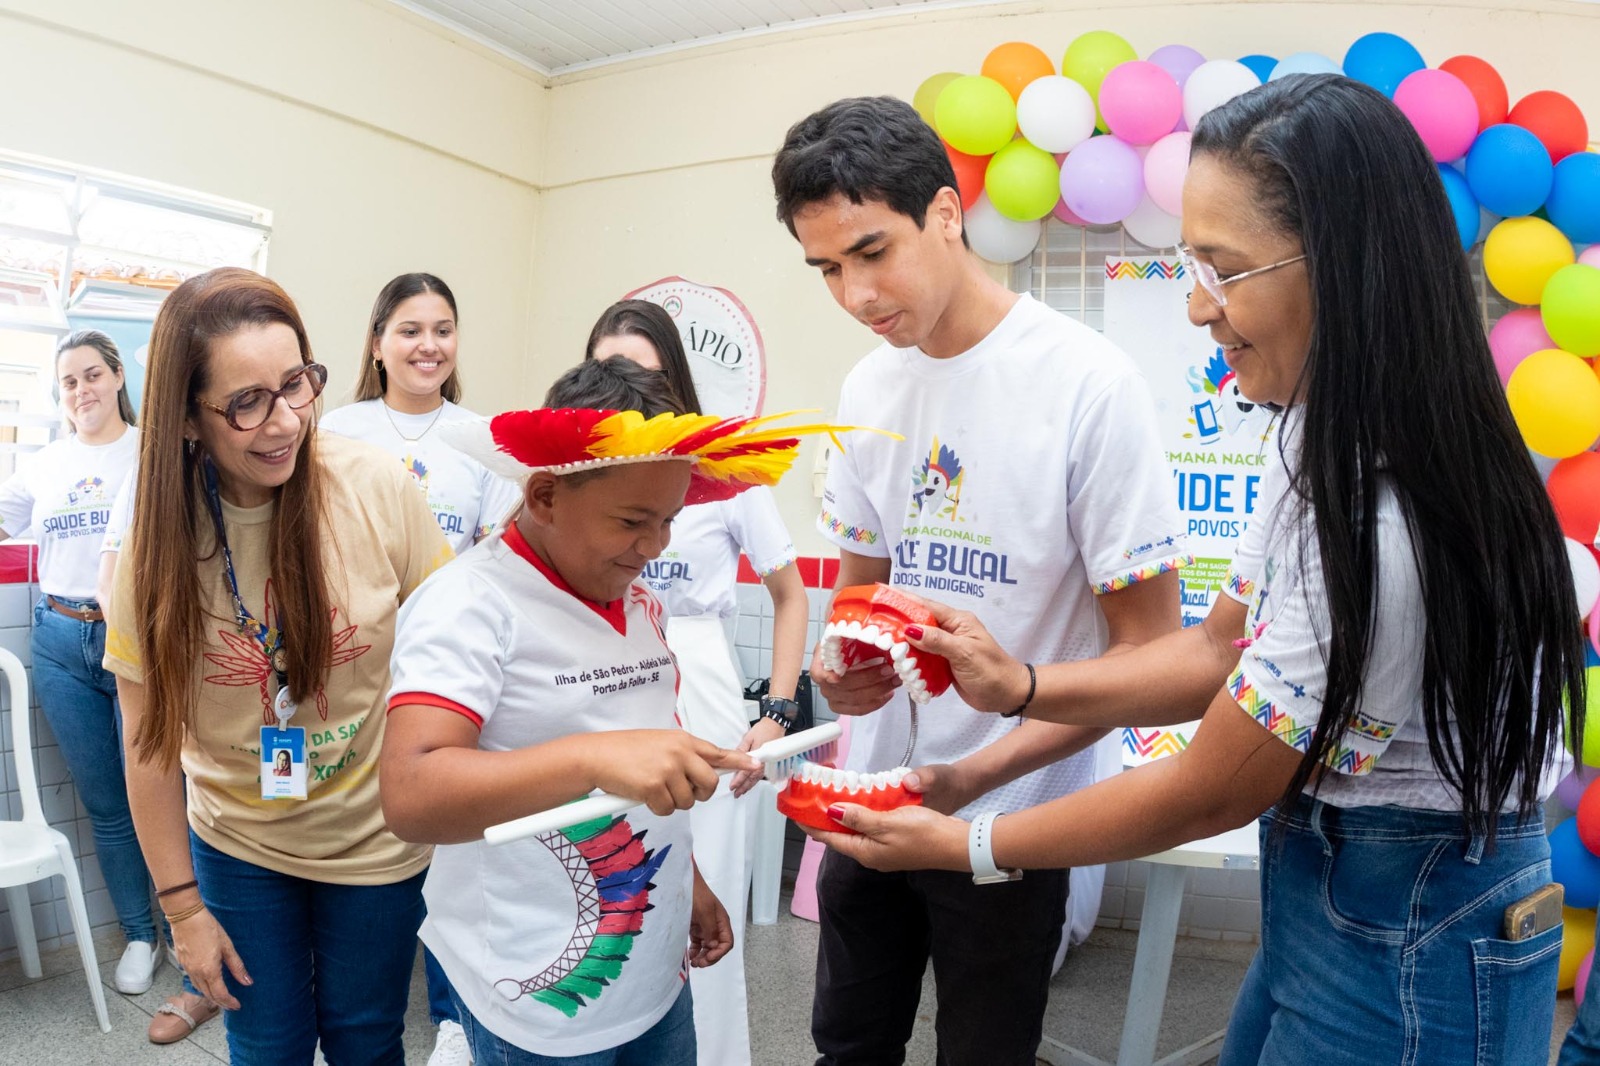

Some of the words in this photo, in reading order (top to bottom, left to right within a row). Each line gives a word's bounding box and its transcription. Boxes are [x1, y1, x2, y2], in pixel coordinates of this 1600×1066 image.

[682, 321, 742, 364] ÁPIO
[1166, 451, 1217, 464] MANA
[43, 512, 87, 533] SAÚDE
[90, 510, 110, 525] BU
[434, 512, 464, 534] CAL
[1188, 518, 1239, 538] POVOS
[920, 526, 975, 542] ACIONAL
[977, 535, 992, 546] DE
[641, 561, 693, 581] UCAL
[927, 542, 1017, 585] BUCAL
[925, 575, 984, 598] INDIGENAS
[554, 675, 577, 686] Ilha
[580, 671, 592, 682] de
[593, 668, 610, 680] São
[611, 664, 634, 677] Pedro
[639, 660, 659, 671] Aldeia
[592, 683, 617, 696] Porto
[618, 679, 627, 690] da
[628, 676, 646, 688] Folha
[651, 671, 660, 683] SE
[311, 730, 336, 747] DA
